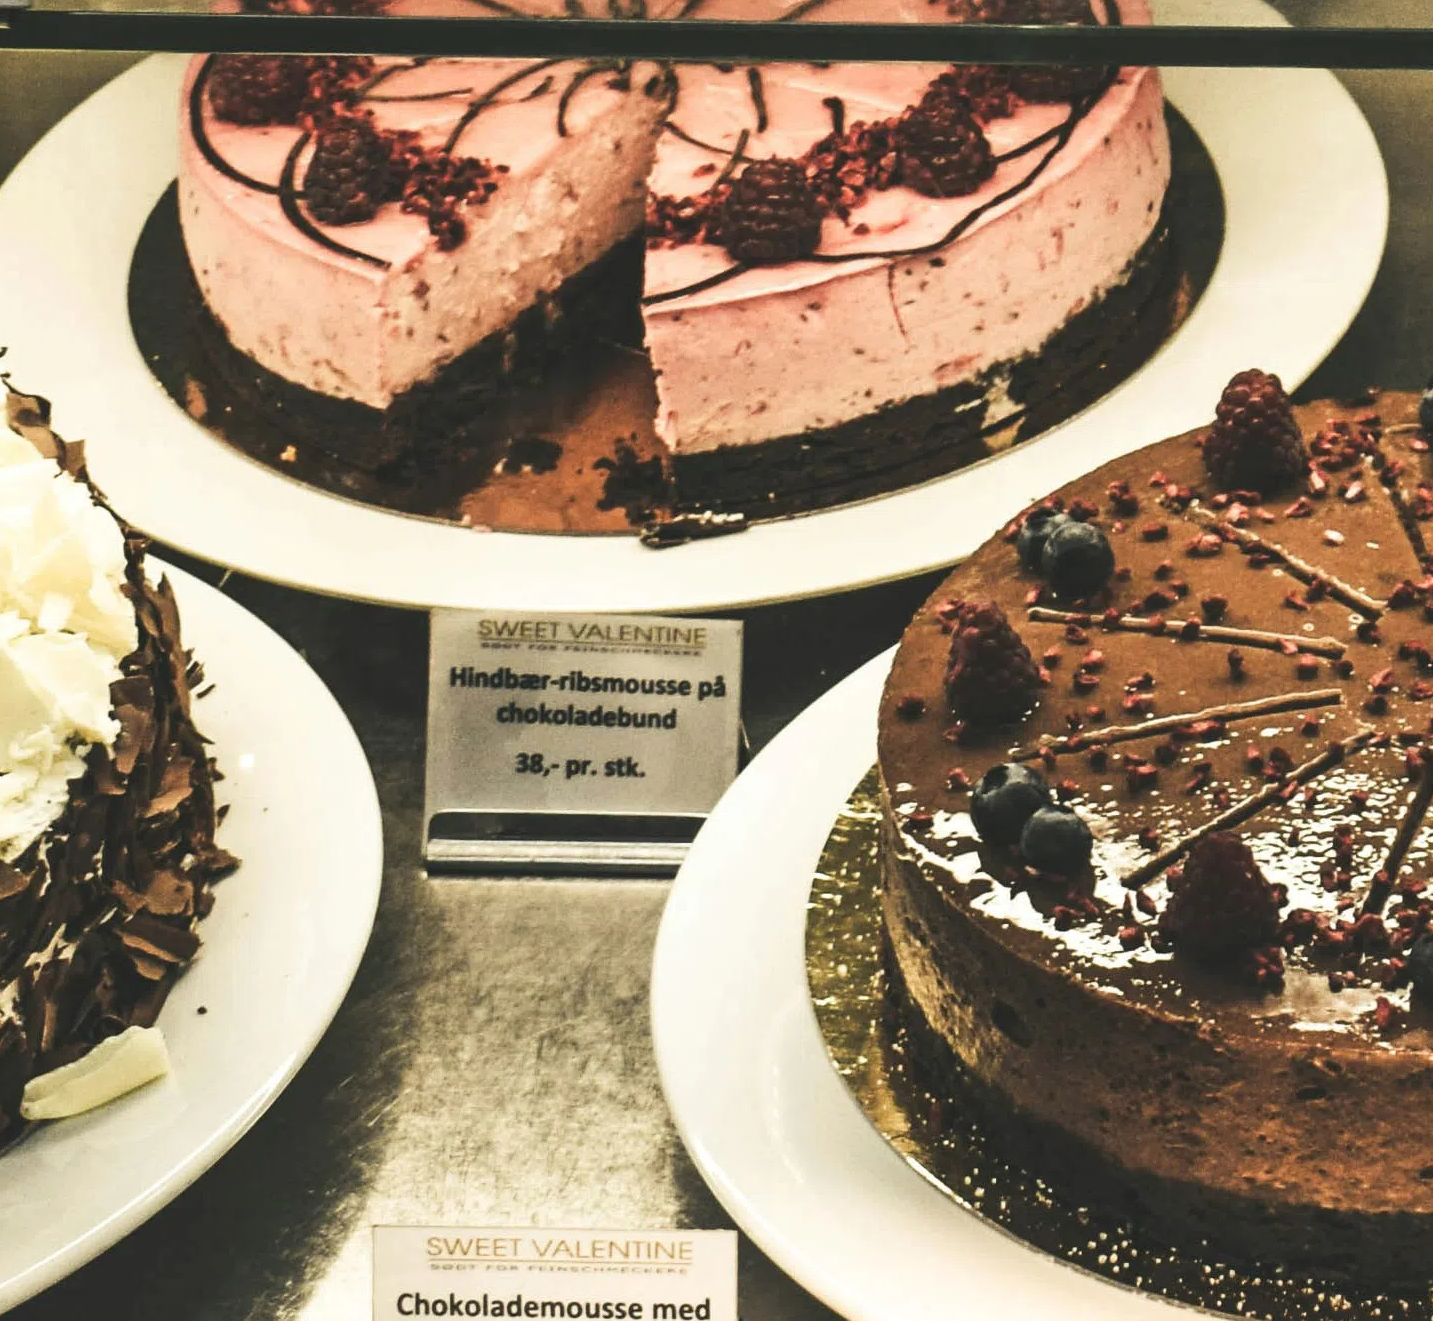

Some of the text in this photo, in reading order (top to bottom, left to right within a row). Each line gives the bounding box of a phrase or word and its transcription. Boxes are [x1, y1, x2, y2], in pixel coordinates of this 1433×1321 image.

[478, 620, 707, 648] SWEET VALENTINE
[449, 667, 727, 701] Hindbær-ribsmousse på
[496, 701, 677, 729] chokoladebund
[515, 753, 646, 779] 38,- pr. stk.
[427, 1237, 694, 1260] SWEET VALENTINE
[396, 1292, 711, 1321] Chokolademousse med
